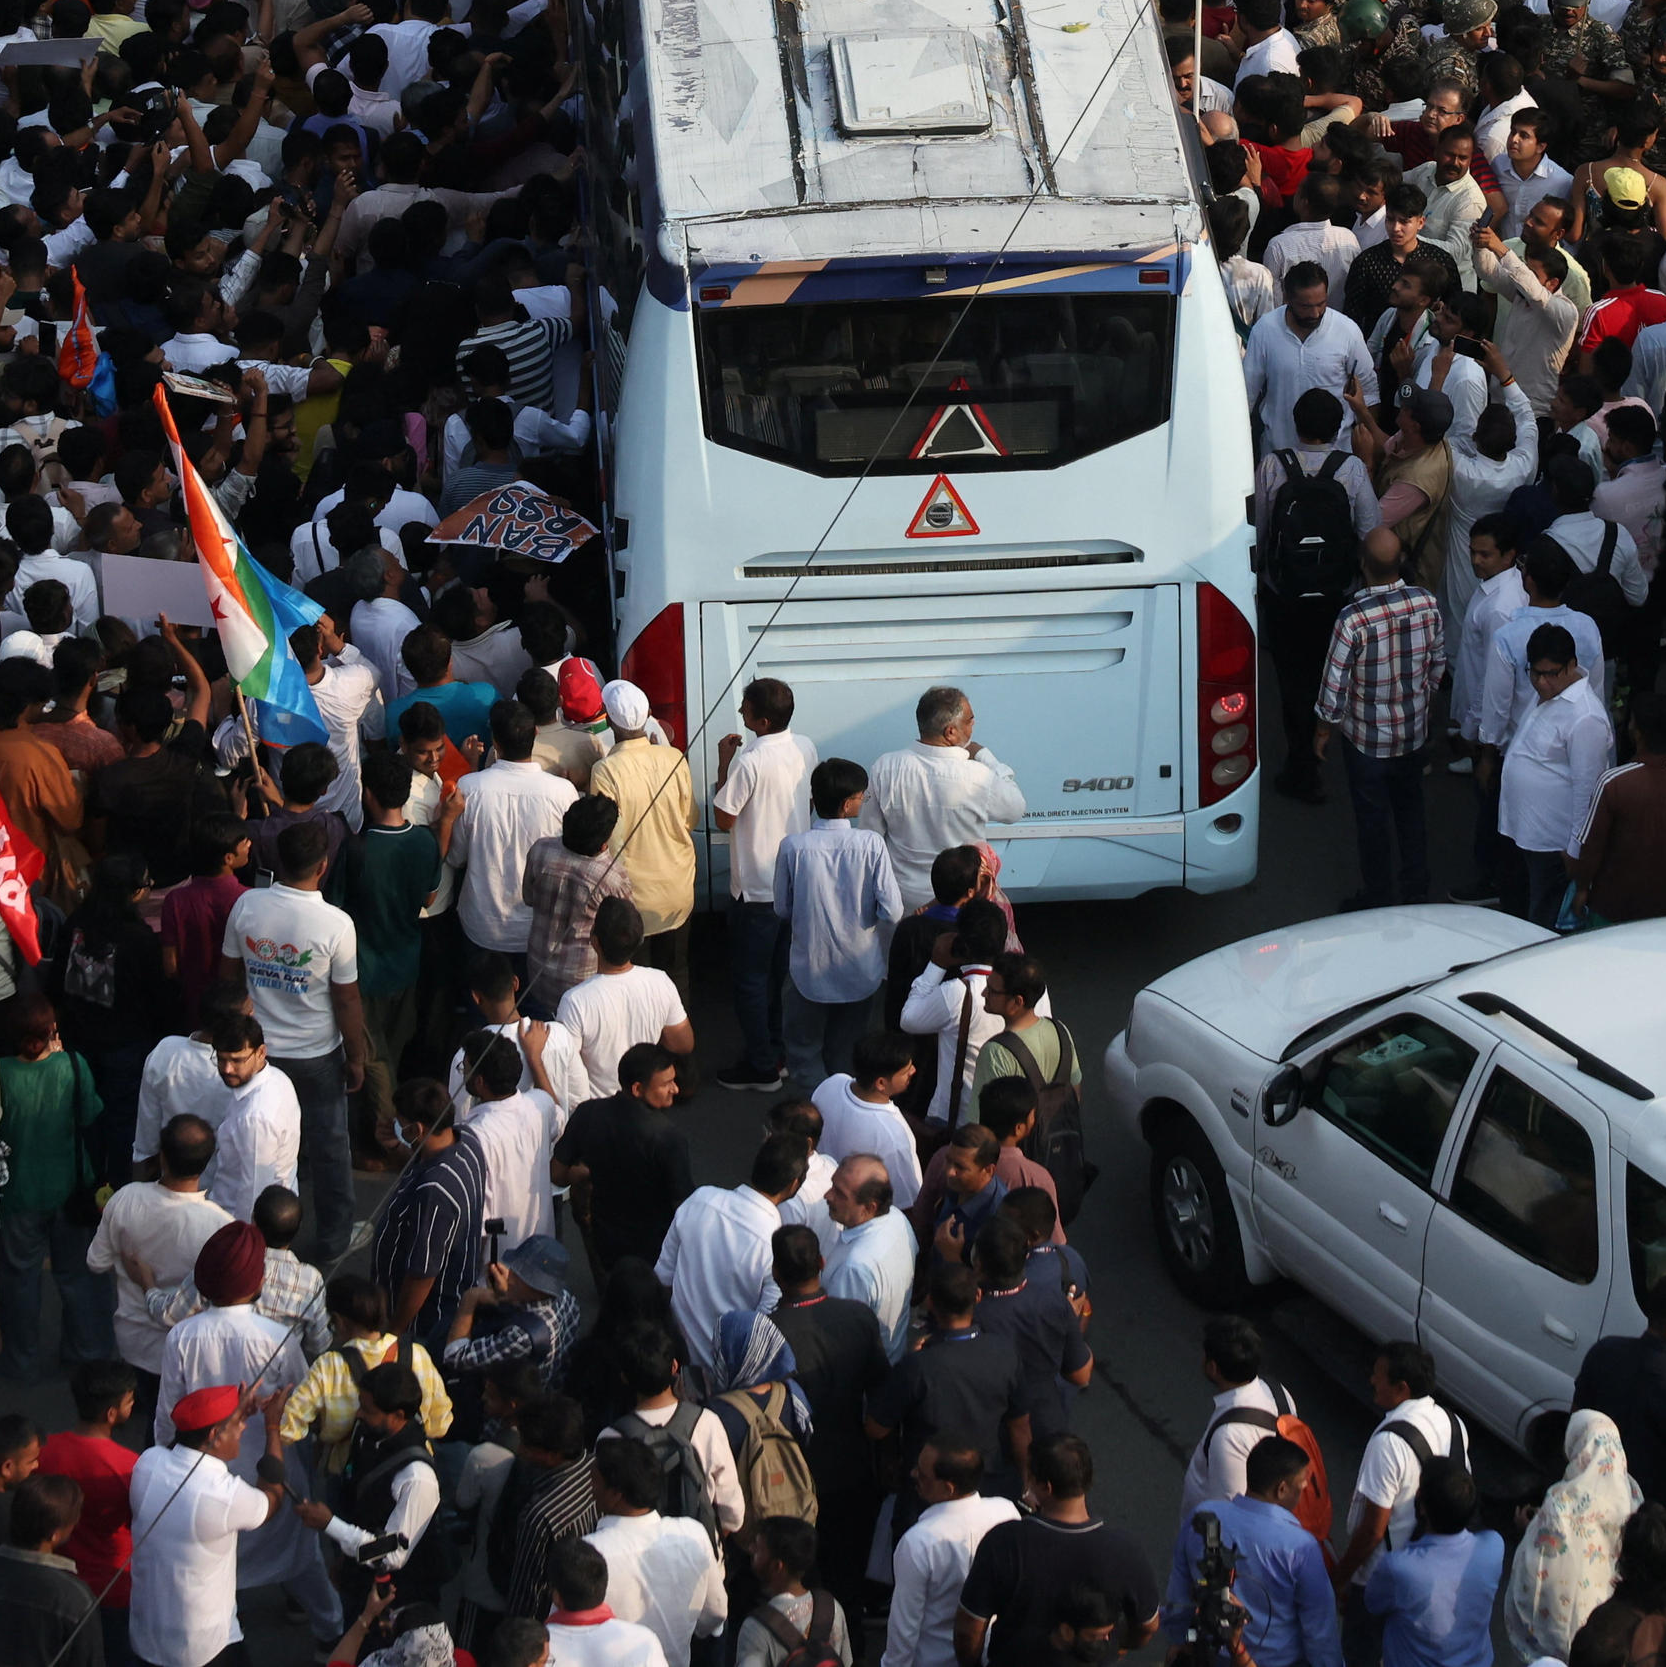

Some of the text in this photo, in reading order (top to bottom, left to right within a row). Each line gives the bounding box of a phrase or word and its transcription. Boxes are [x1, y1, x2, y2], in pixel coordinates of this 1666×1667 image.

[487, 485, 583, 535] RSS
[460, 514, 574, 562] BAN
[1062, 775, 1135, 793] 9400
[1031, 811, 1046, 819] RAIL
[1047, 810, 1070, 818] DIRECT
[1071, 808, 1103, 817] INJECTION
[1103, 807, 1129, 815] SYSTEM
